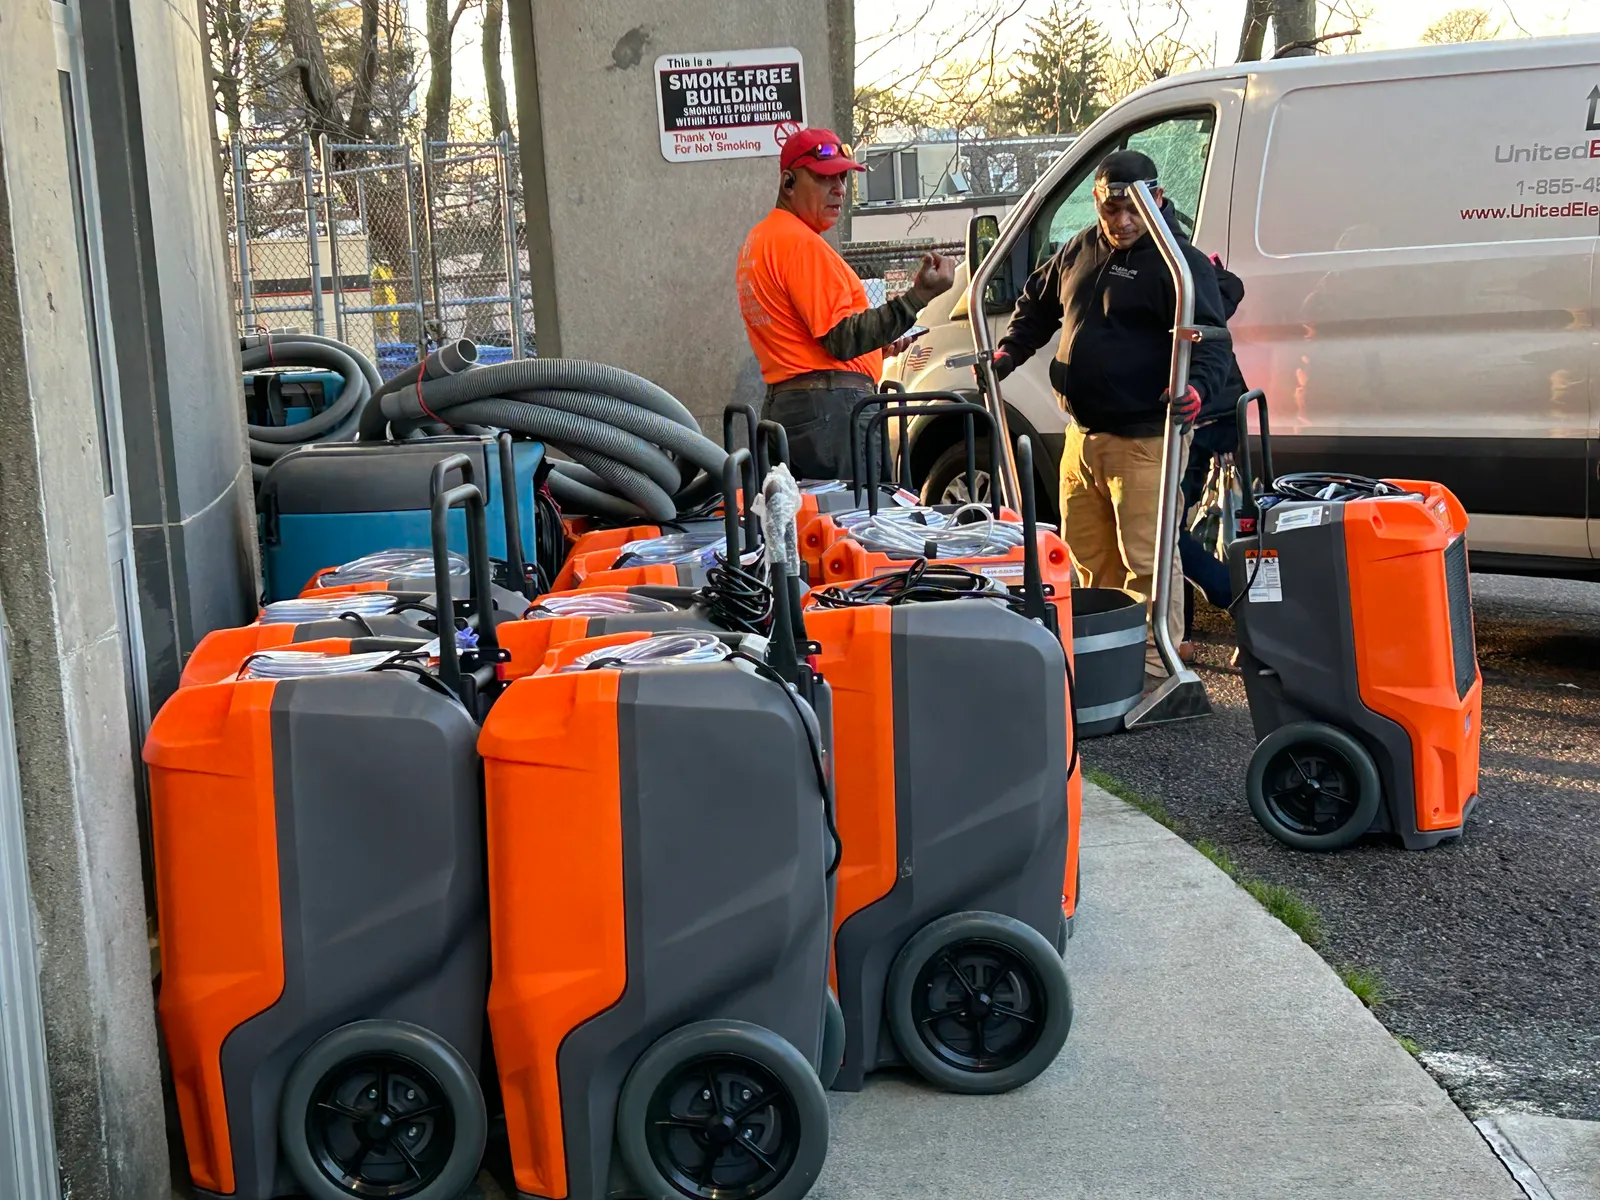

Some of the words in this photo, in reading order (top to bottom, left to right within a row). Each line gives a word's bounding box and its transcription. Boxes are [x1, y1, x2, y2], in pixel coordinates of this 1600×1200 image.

[667, 58, 690, 68] This
[694, 56, 702, 66] is
[669, 67, 792, 90] SMOKE-FREE
[686, 86, 778, 106] BUILDING
[683, 105, 722, 117] SMOKING
[724, 104, 732, 114] IS
[734, 102, 782, 113] PROHIBITED
[676, 115, 706, 127] WITHIN
[708, 115, 718, 125] 15
[720, 114, 738, 124] FEET
[741, 112, 752, 122] OF
[754, 110, 792, 122] BUILDING
[673, 131, 705, 144] Thank
[708, 130, 728, 141] You
[674, 144, 691, 154] For
[695, 143, 713, 153] Not
[716, 140, 761, 152] Smoking
